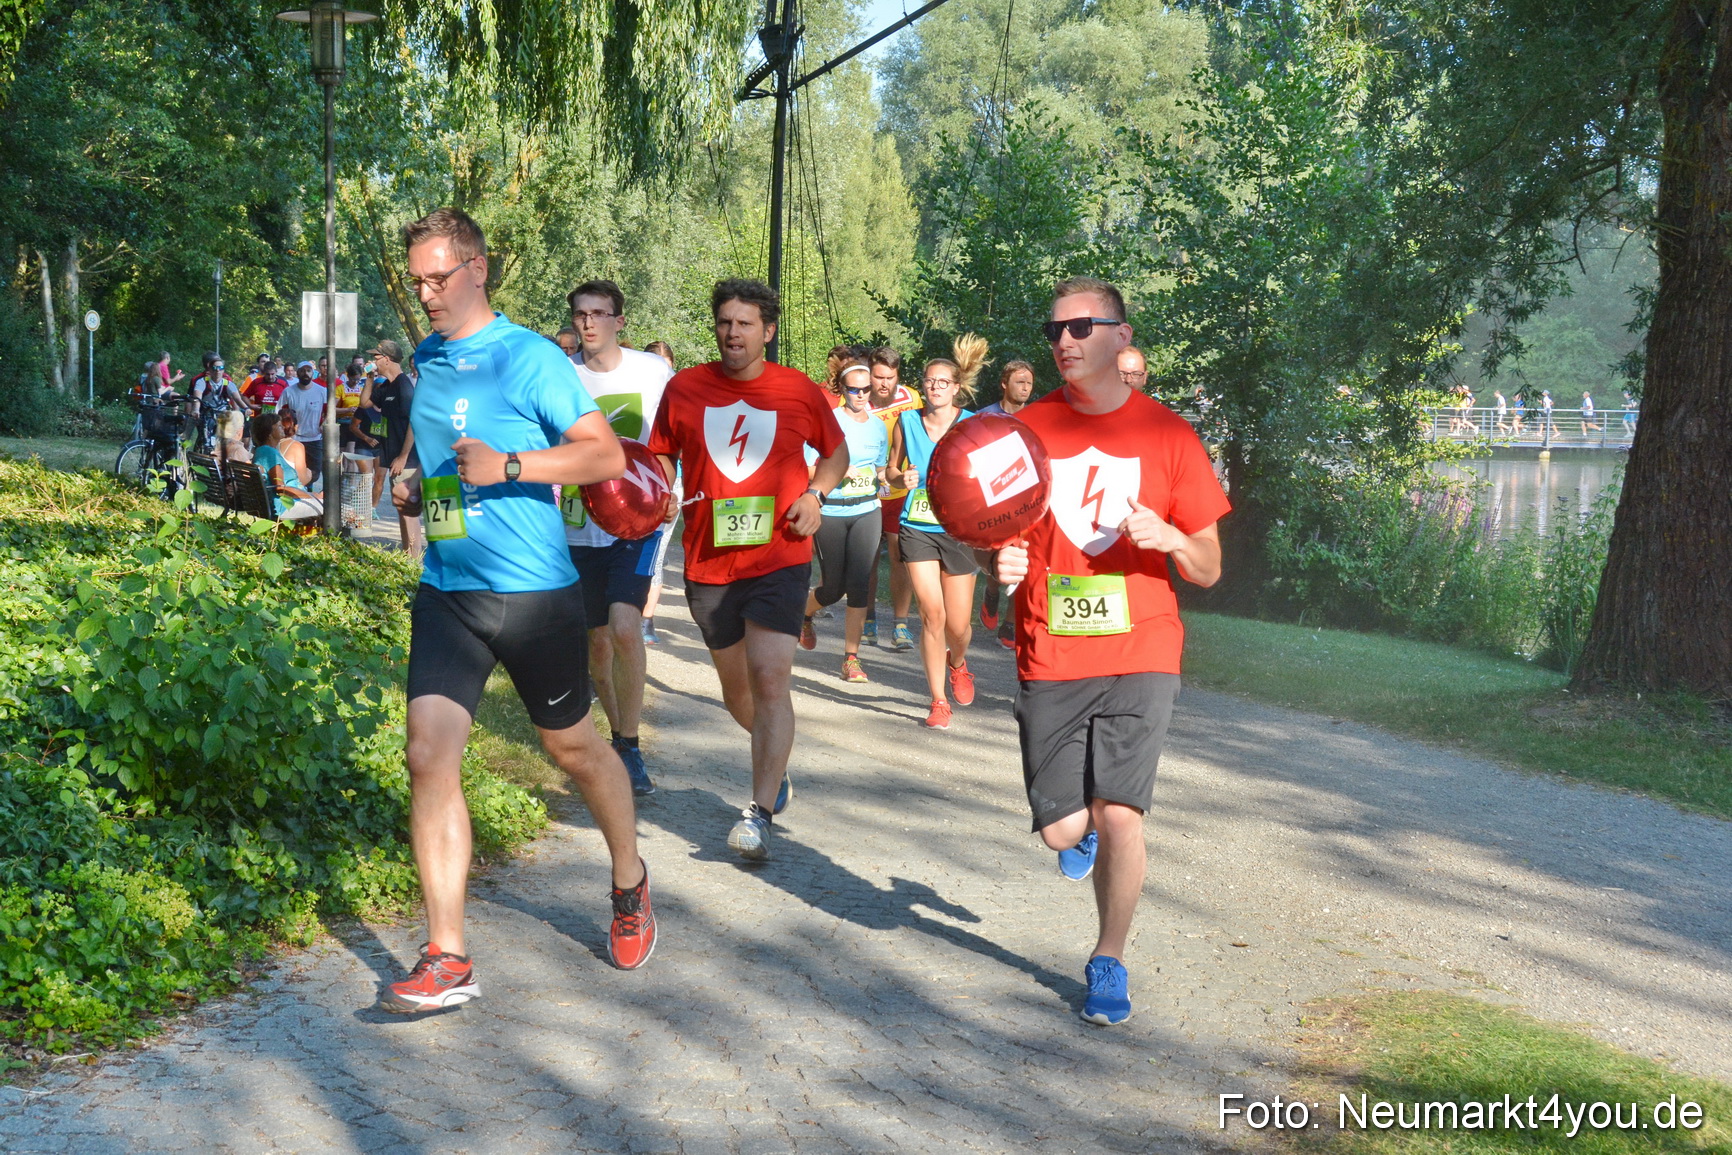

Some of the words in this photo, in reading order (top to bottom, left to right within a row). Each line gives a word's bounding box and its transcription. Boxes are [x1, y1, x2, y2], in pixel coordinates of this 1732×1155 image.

[851, 477, 870, 488] 626
[1001, 467, 1018, 486] DEHN
[728, 514, 762, 531] 397
[977, 511, 1011, 531] DEHN
[1063, 597, 1108, 618] 394
